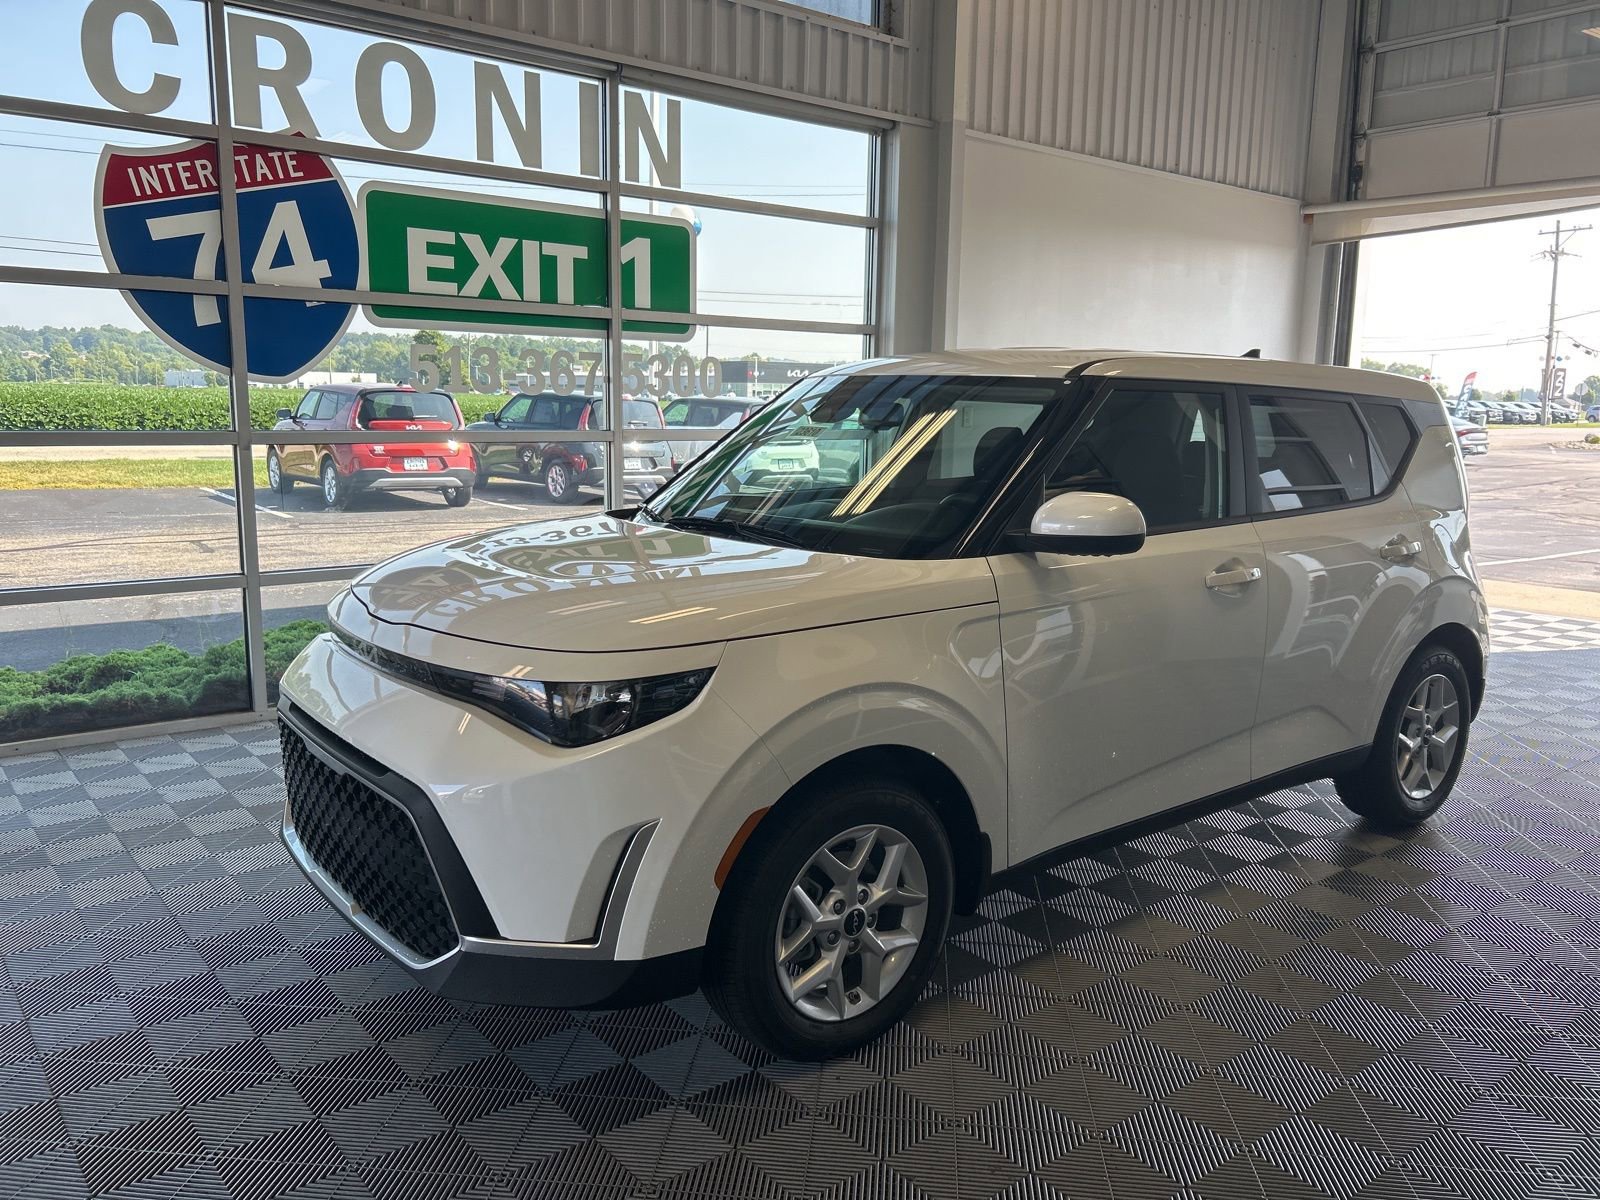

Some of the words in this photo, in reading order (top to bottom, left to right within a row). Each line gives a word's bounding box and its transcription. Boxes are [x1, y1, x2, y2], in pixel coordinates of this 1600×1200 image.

[81, 0, 682, 189] CRONIN
[127, 151, 304, 197] INTERTATE
[146, 200, 333, 327] 74
[406, 226, 589, 305] EXIT
[620, 236, 652, 310] 1
